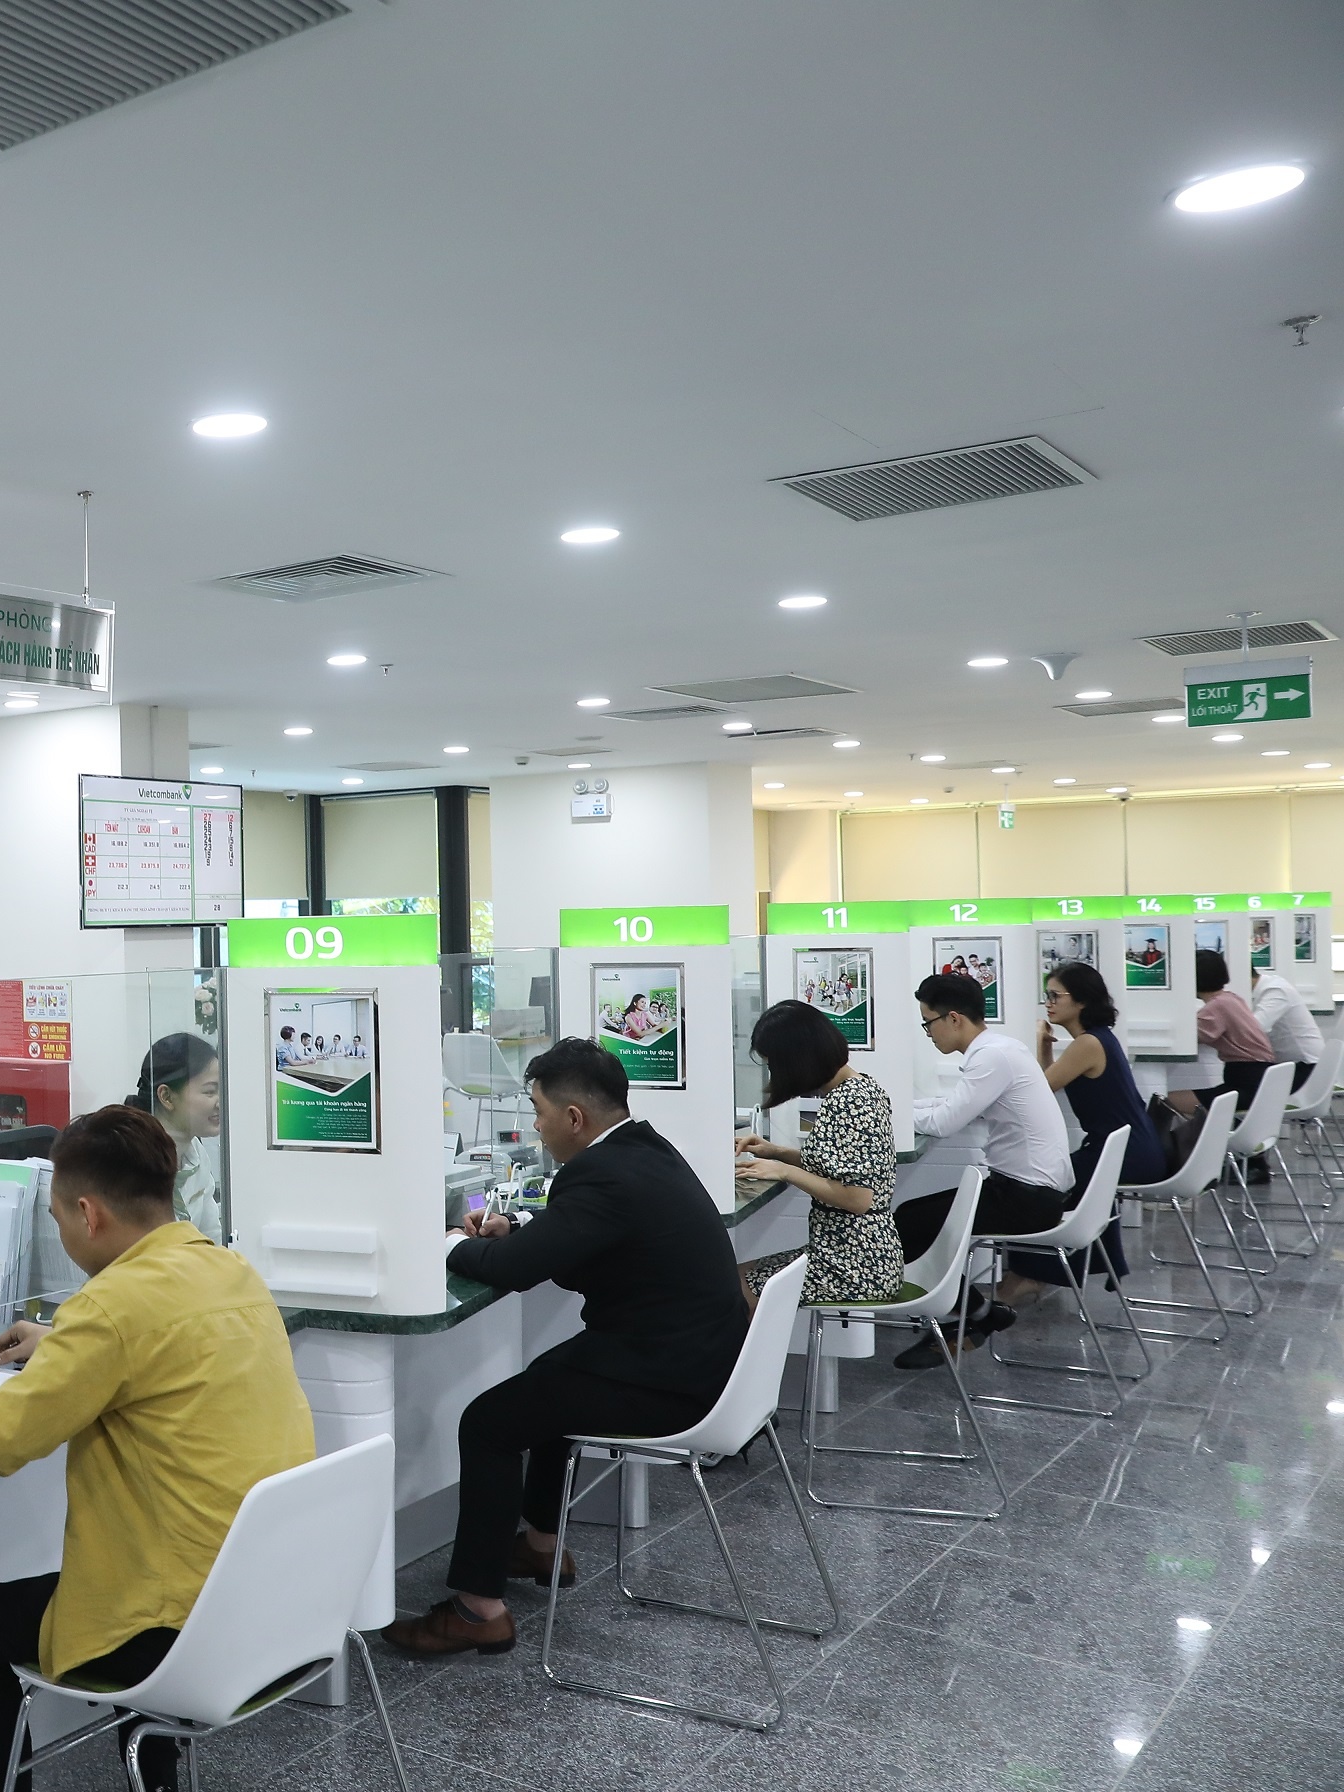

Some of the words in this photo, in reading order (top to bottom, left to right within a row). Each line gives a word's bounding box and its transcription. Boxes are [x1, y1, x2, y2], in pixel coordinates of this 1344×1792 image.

[24, 639, 52, 669] HÀNG
[74, 651, 100, 675] NHÂN
[1196, 686, 1230, 700] EXIT
[138, 788, 182, 800] Vietcombank
[203, 813, 212, 821] 27
[227, 814, 234, 822] 12
[85, 845, 96, 853] CAD
[85, 867, 96, 875] CHF
[85, 889, 96, 897] JPY
[1057, 899, 1084, 916] 13
[1136, 898, 1162, 913] 14
[1193, 897, 1216, 910] 15
[821, 907, 848, 929] 11
[949, 903, 979, 922] 12
[613, 916, 654, 942] 10
[284, 926, 344, 960] 09
